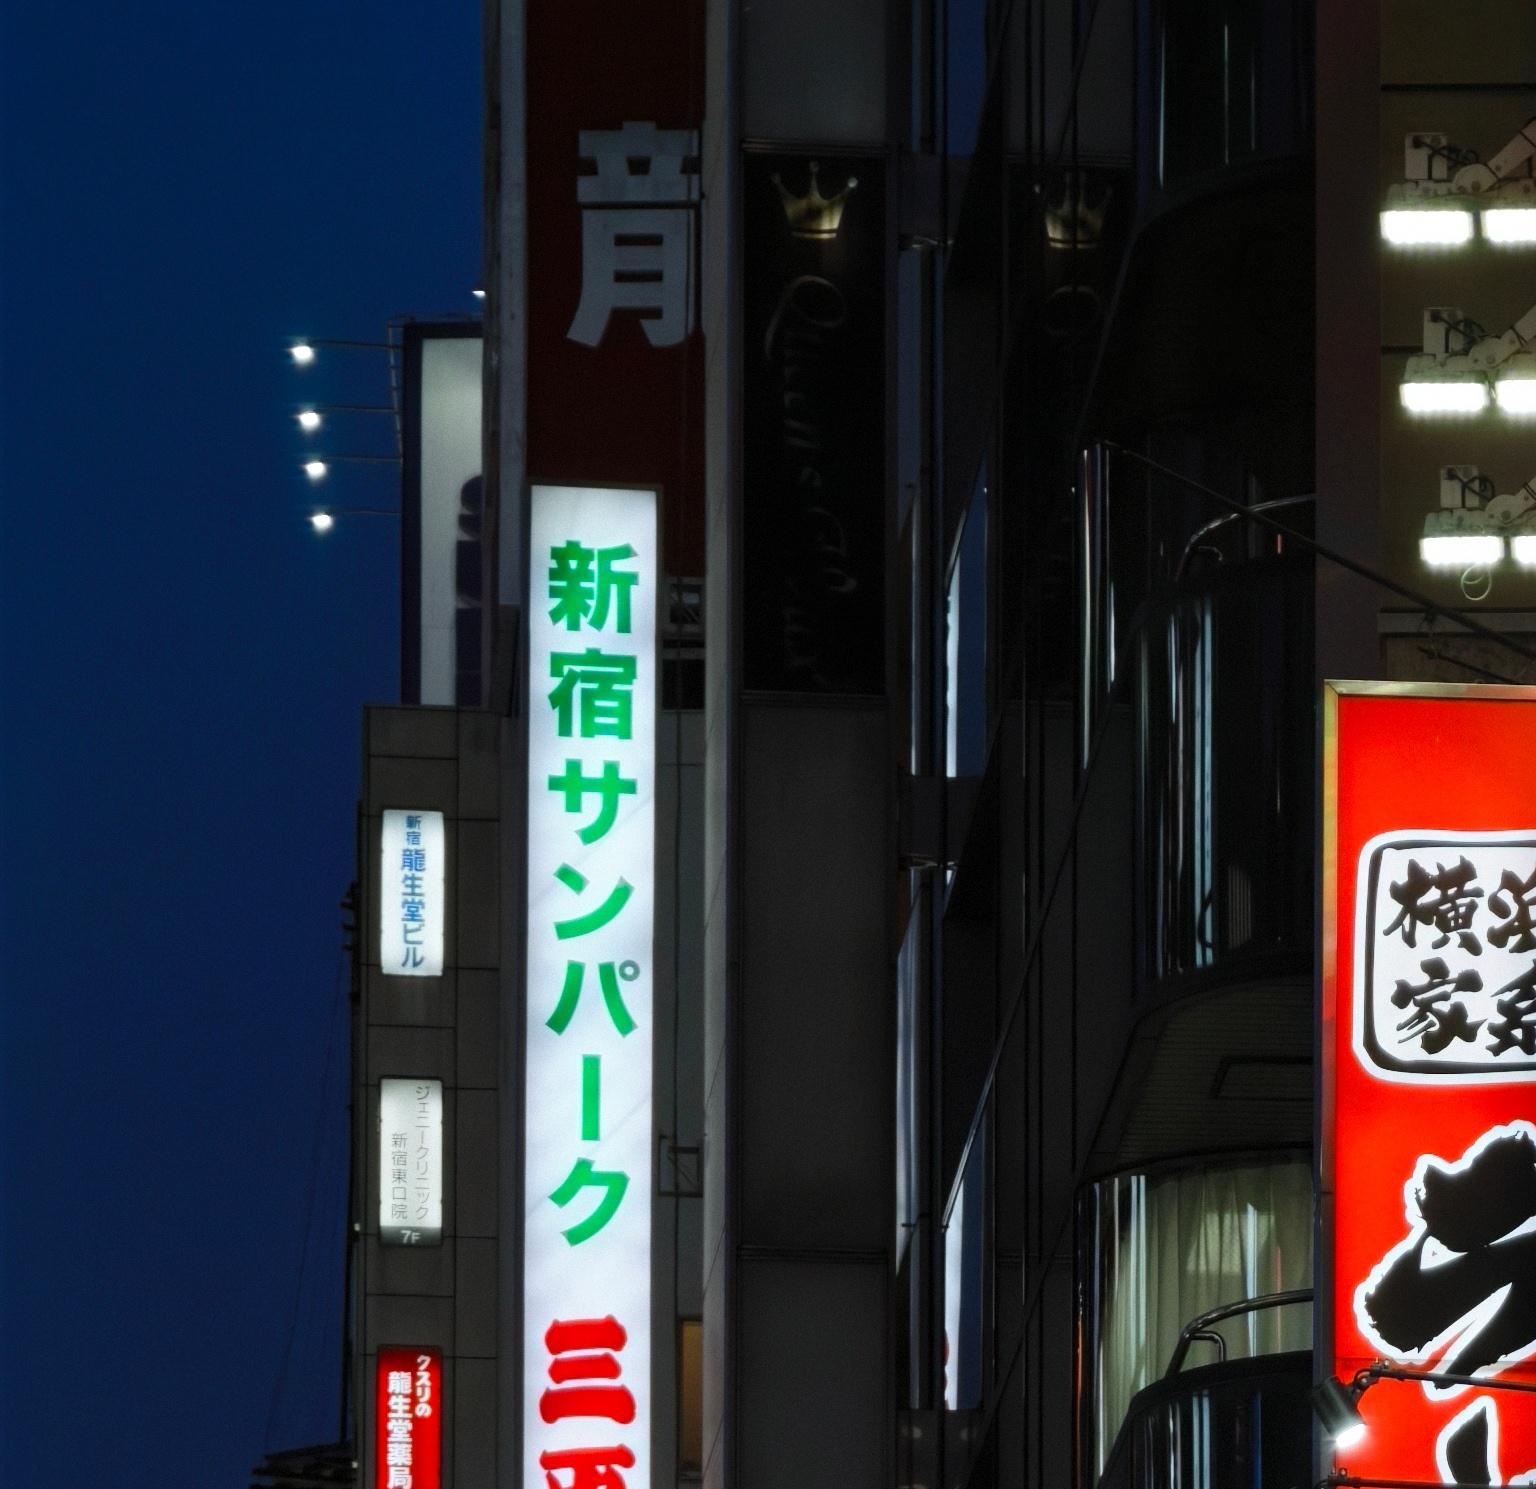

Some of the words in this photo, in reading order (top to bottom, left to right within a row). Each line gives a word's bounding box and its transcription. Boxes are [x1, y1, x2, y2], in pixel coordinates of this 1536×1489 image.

[401, 815, 426, 969] 新宿龍生堂ビル
[546, 540, 640, 1247] 新宿サンパーク
[401, 1230, 422, 1244] 7F
[414, 1354, 433, 1419] クスリの
